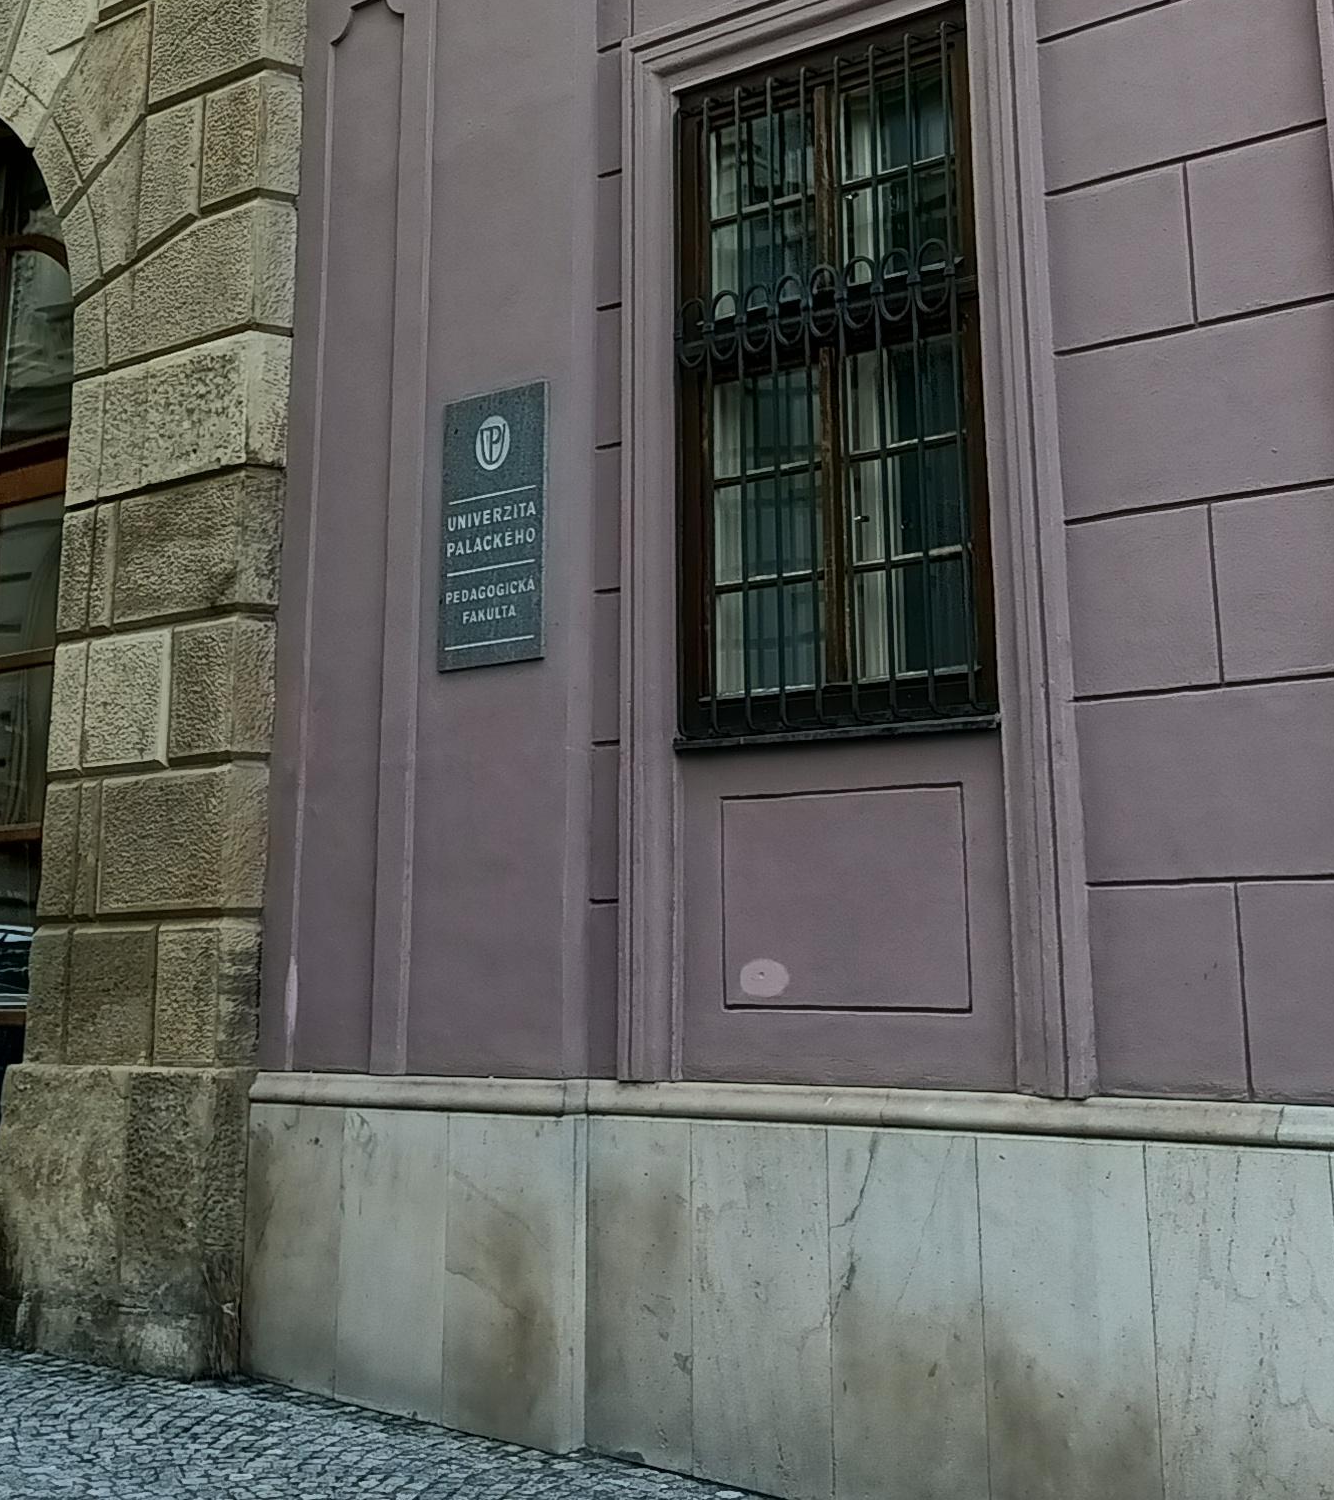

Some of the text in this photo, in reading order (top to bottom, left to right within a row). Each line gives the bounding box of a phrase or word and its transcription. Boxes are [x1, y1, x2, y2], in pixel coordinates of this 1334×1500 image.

[447, 501, 536, 532] UNIVERZITA
[447, 527, 536, 557] PALACKÉHO
[445, 575, 535, 604] PEDAGOGICKÁ
[462, 604, 516, 624] FAKULTA
